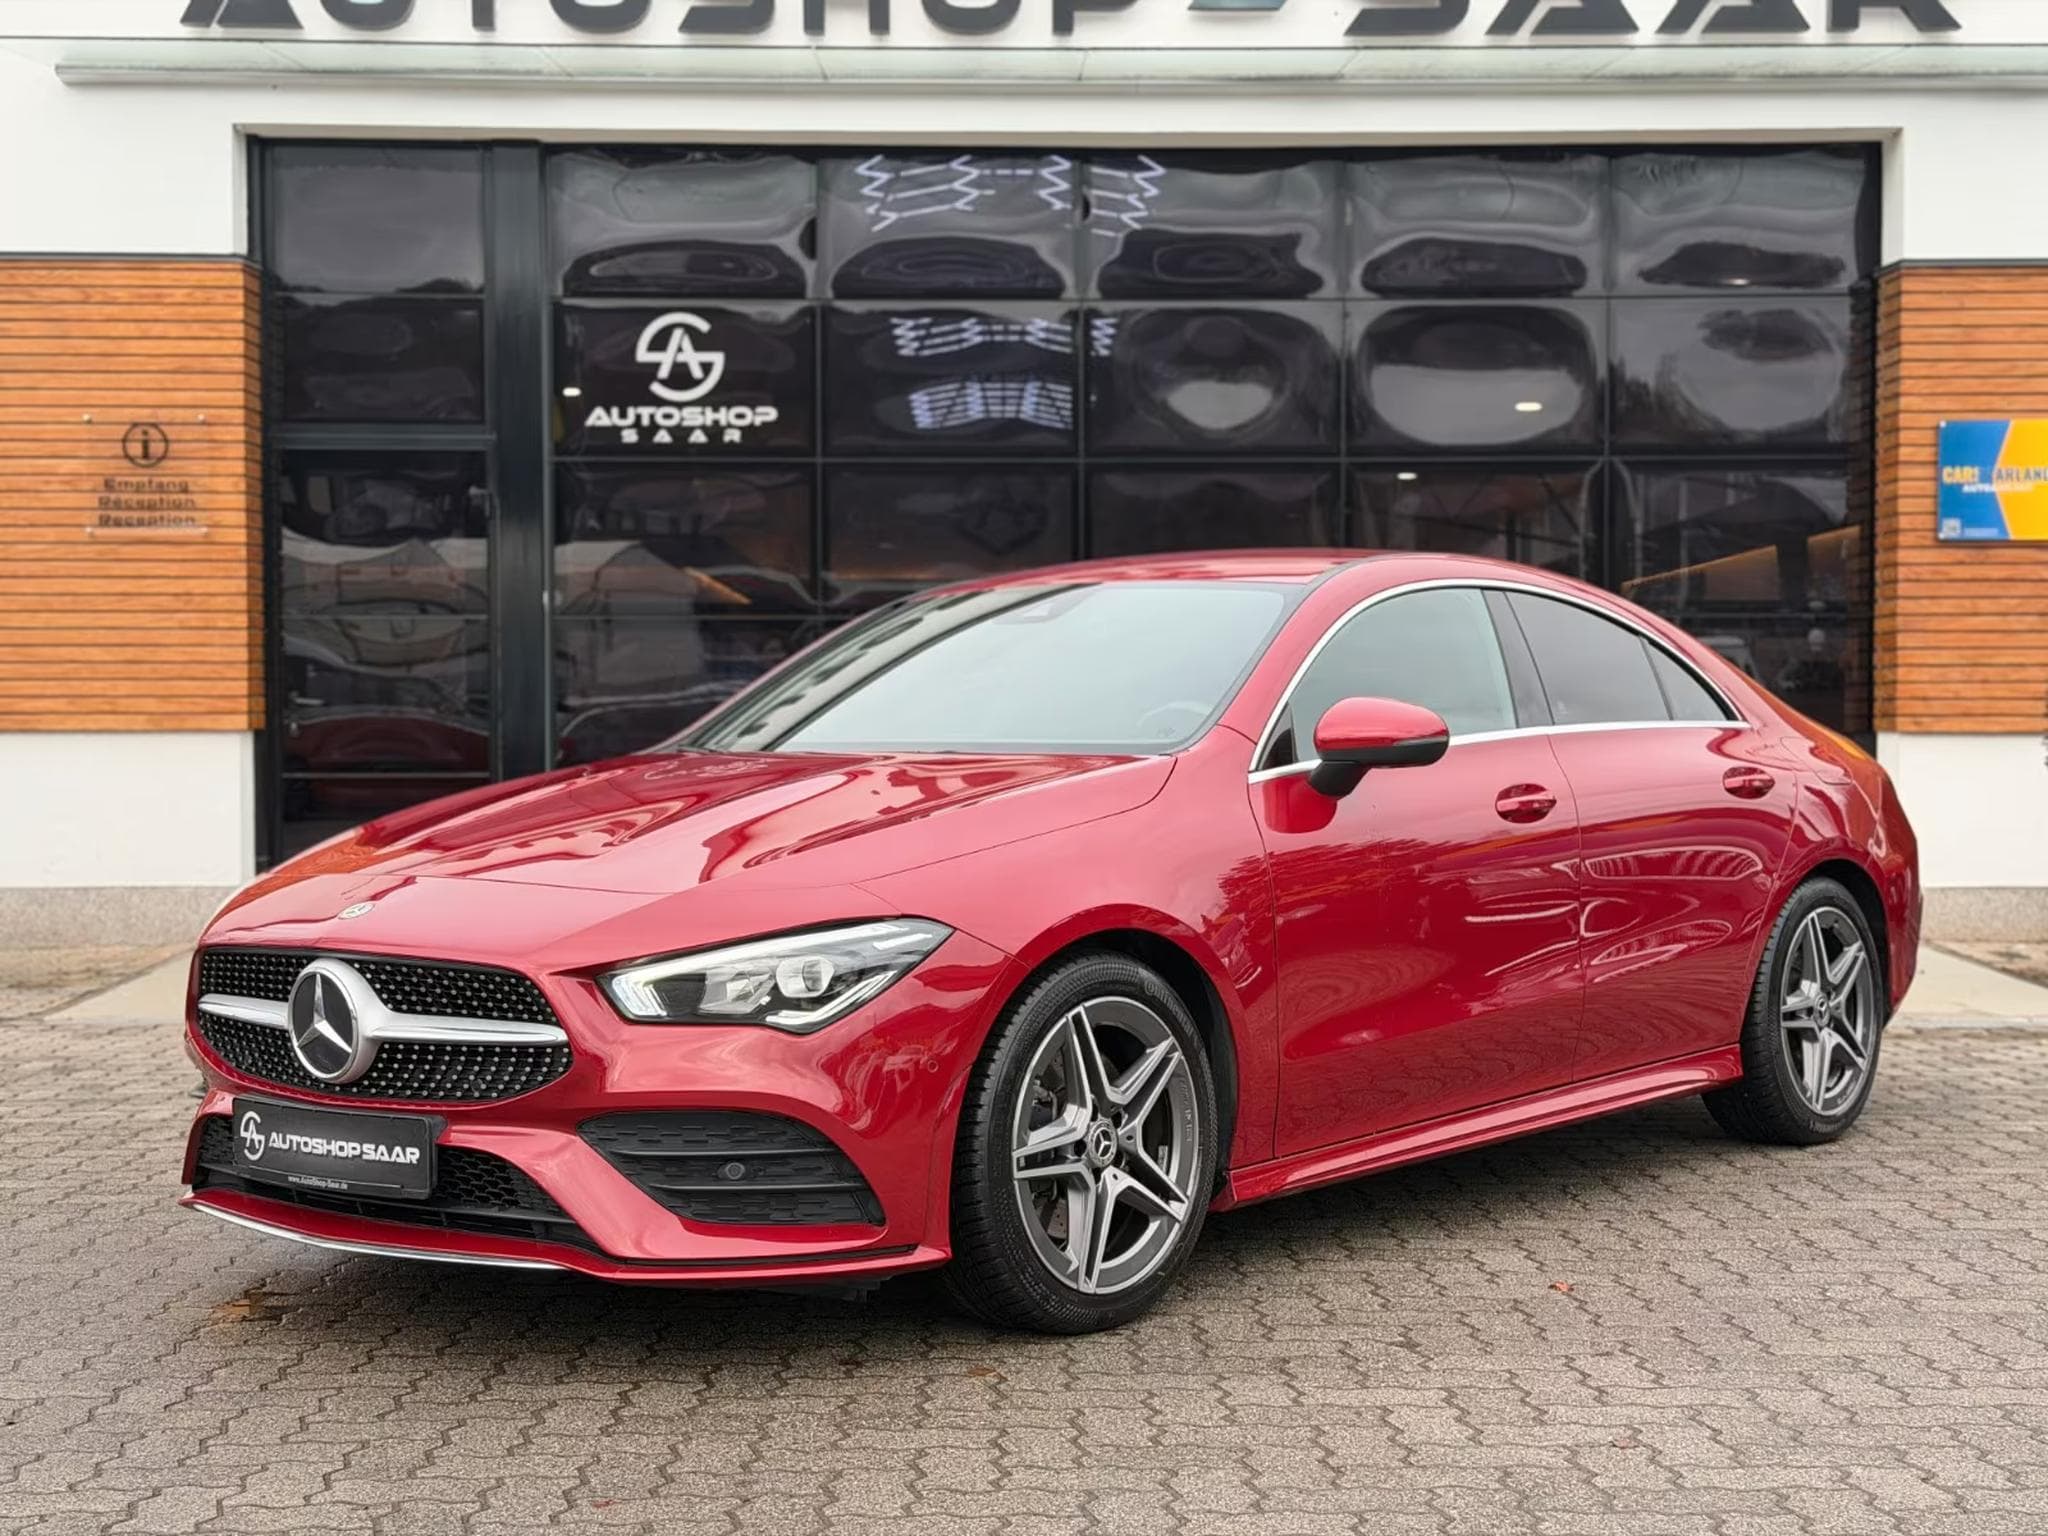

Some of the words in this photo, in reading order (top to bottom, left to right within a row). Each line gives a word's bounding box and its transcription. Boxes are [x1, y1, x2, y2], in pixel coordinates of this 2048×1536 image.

[584, 406, 779, 427] AUTOSHOP
[620, 428, 743, 444] SAAR
[104, 478, 190, 494] Empfang
[98, 513, 197, 528] Reception
[268, 1131, 361, 1158] AUTOSHOP
[361, 1143, 421, 1165] SAAR
